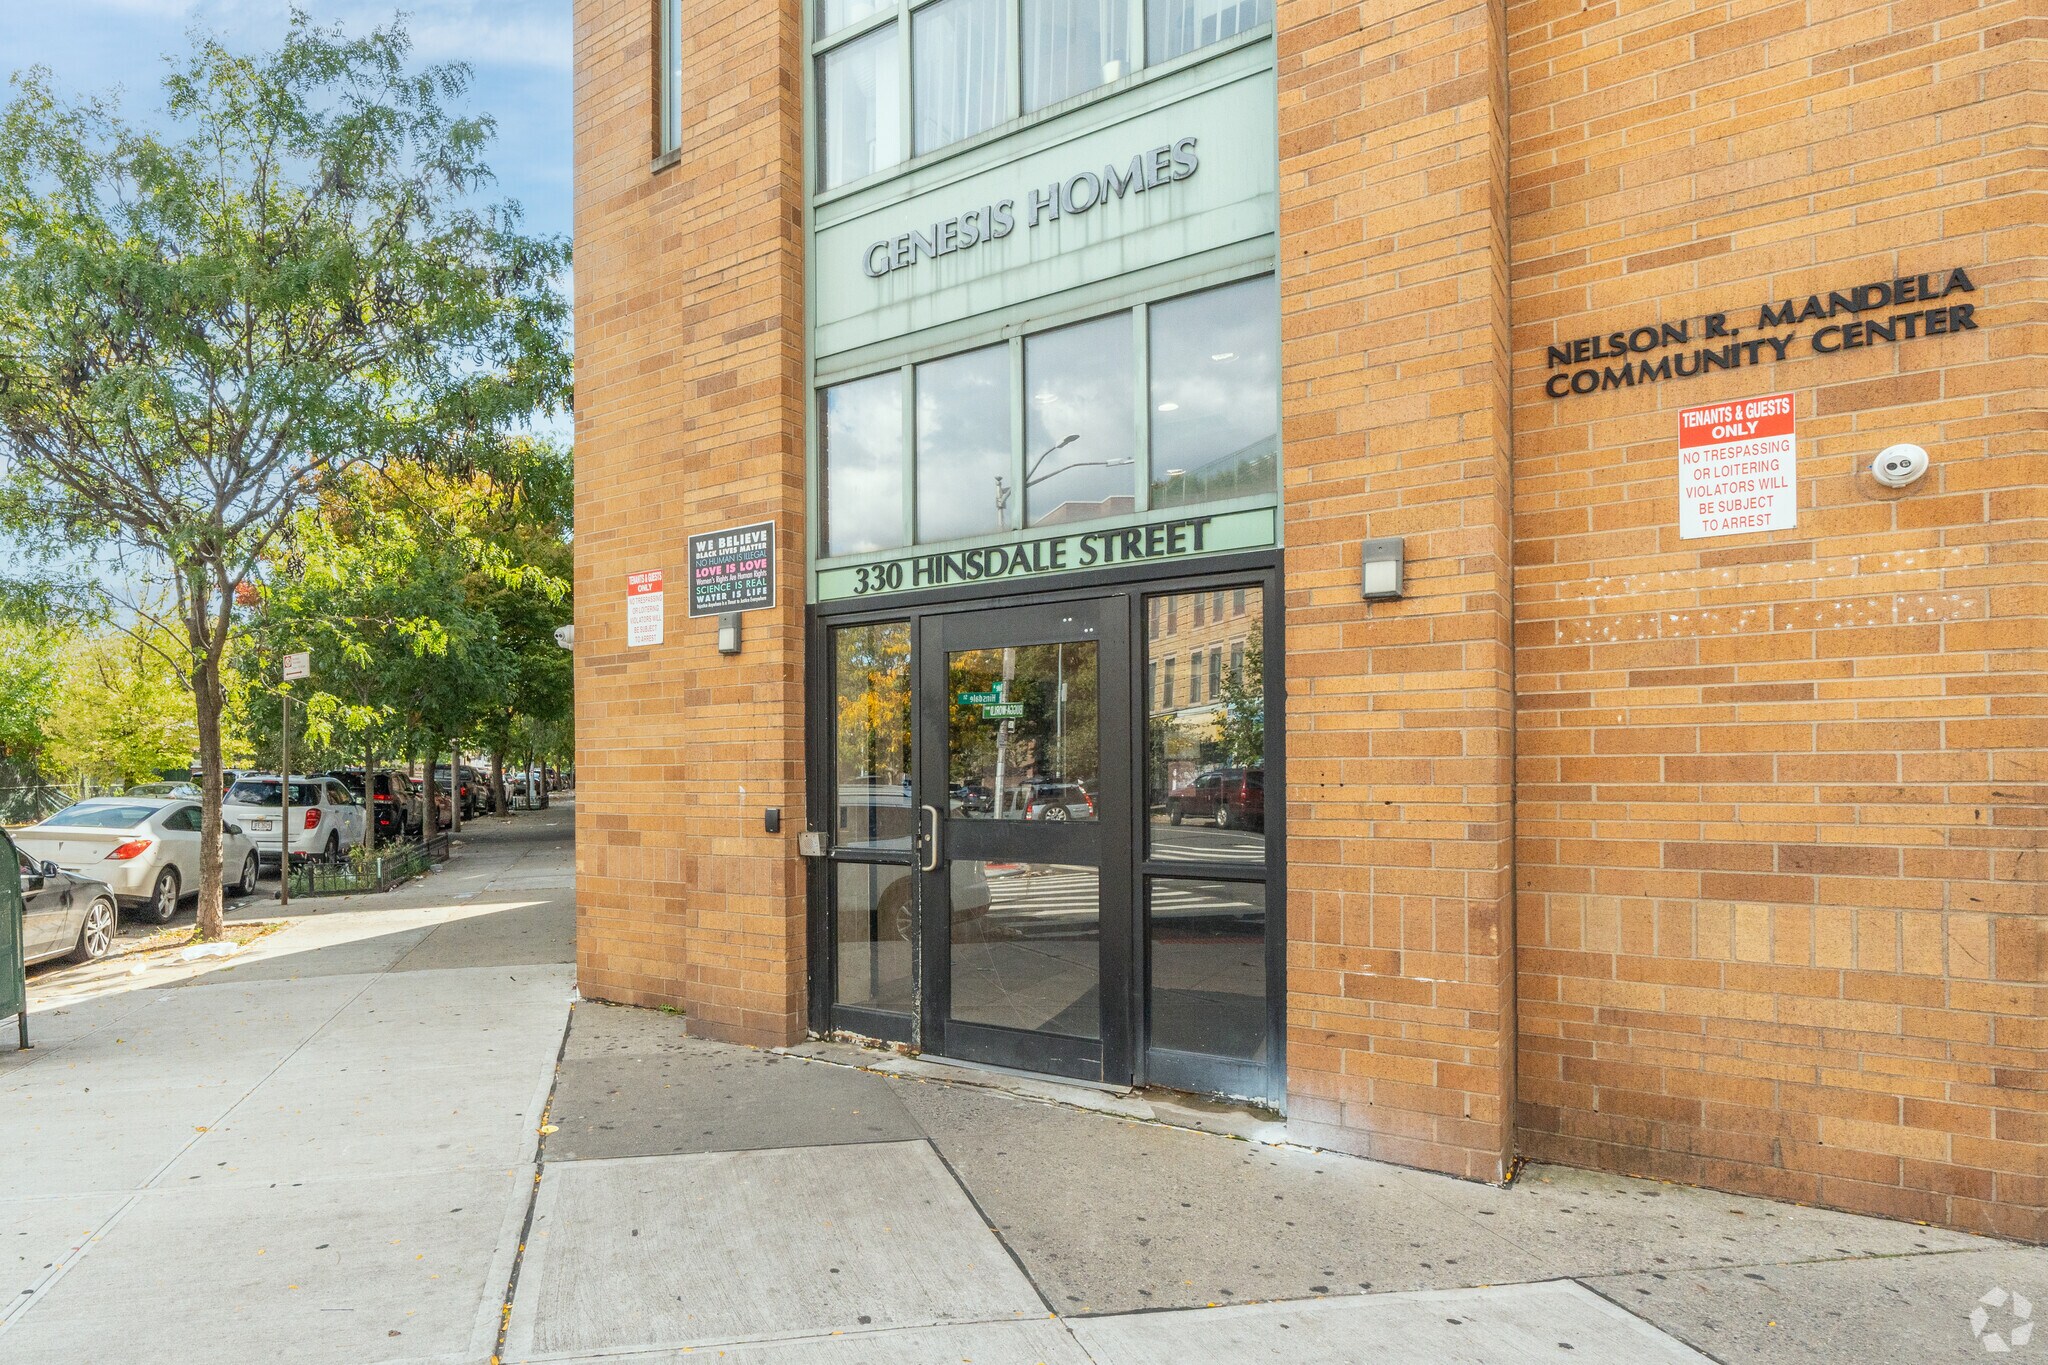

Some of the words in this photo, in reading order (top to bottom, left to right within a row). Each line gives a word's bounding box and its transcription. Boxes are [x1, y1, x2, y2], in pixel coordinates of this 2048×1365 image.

[863, 198, 1015, 278] GENESIS
[1029, 136, 1199, 228] HOMES
[1547, 319, 1688, 368] NELSON
[1705, 311, 1739, 339] R.
[1758, 267, 1975, 330] MANDELA
[1545, 333, 1796, 398] COMMUNITY
[1812, 303, 1978, 353] CENTER
[1682, 406, 1732, 428] TENANTS
[1735, 405, 1743, 421] &
[1745, 397, 1790, 419] GUESTS
[1712, 421, 1759, 439] ONLY
[1683, 451, 1700, 465] NO
[1704, 439, 1790, 462] TRESPASSING
[1694, 468, 1710, 480] OR
[1714, 459, 1779, 478] LOITERING
[1686, 481, 1755, 498] VIOLATORS
[1759, 476, 1788, 490] WILL
[1699, 502, 1714, 515] BE
[1718, 495, 1774, 512] SUBJECT
[1703, 519, 1718, 532] TO
[1722, 513, 1771, 530] ARREST
[696, 540, 713, 552] WE
[718, 530, 767, 549] BELIEVE
[696, 550, 717, 559] BLACK
[719, 547, 737, 556] LIVES
[739, 542, 767, 552] MATTER
[696, 559, 707, 567] NO
[709, 555, 735, 565] HUMAN
[736, 553, 742, 561] IS
[744, 550, 767, 559] ILLEGAL
[853, 562, 904, 594] 330
[912, 538, 1066, 587] HINSDALE
[1079, 517, 1211, 566] STREET
[696, 566, 721, 578] LOVE
[726, 563, 736, 573] IS
[740, 558, 767, 571] LOVE
[696, 577, 715, 586] Women's
[716, 575, 728, 584] Rights
[737, 572, 753, 580] Human
[754, 569, 767, 578] Rights
[638, 583, 652, 592] ONLY
[696, 582, 731, 595] SCIENCE
[735, 581, 743, 590] IS
[746, 577, 767, 588] REAL
[696, 593, 727, 603] WATER
[732, 590, 741, 599] IS
[747, 587, 767, 597] LIFE
[635, 595, 662, 604] TRESPASSING
[639, 605, 659, 614] LOITERING
[640, 624, 657, 633] SUBJECT
[641, 634, 656, 642] ARREST
